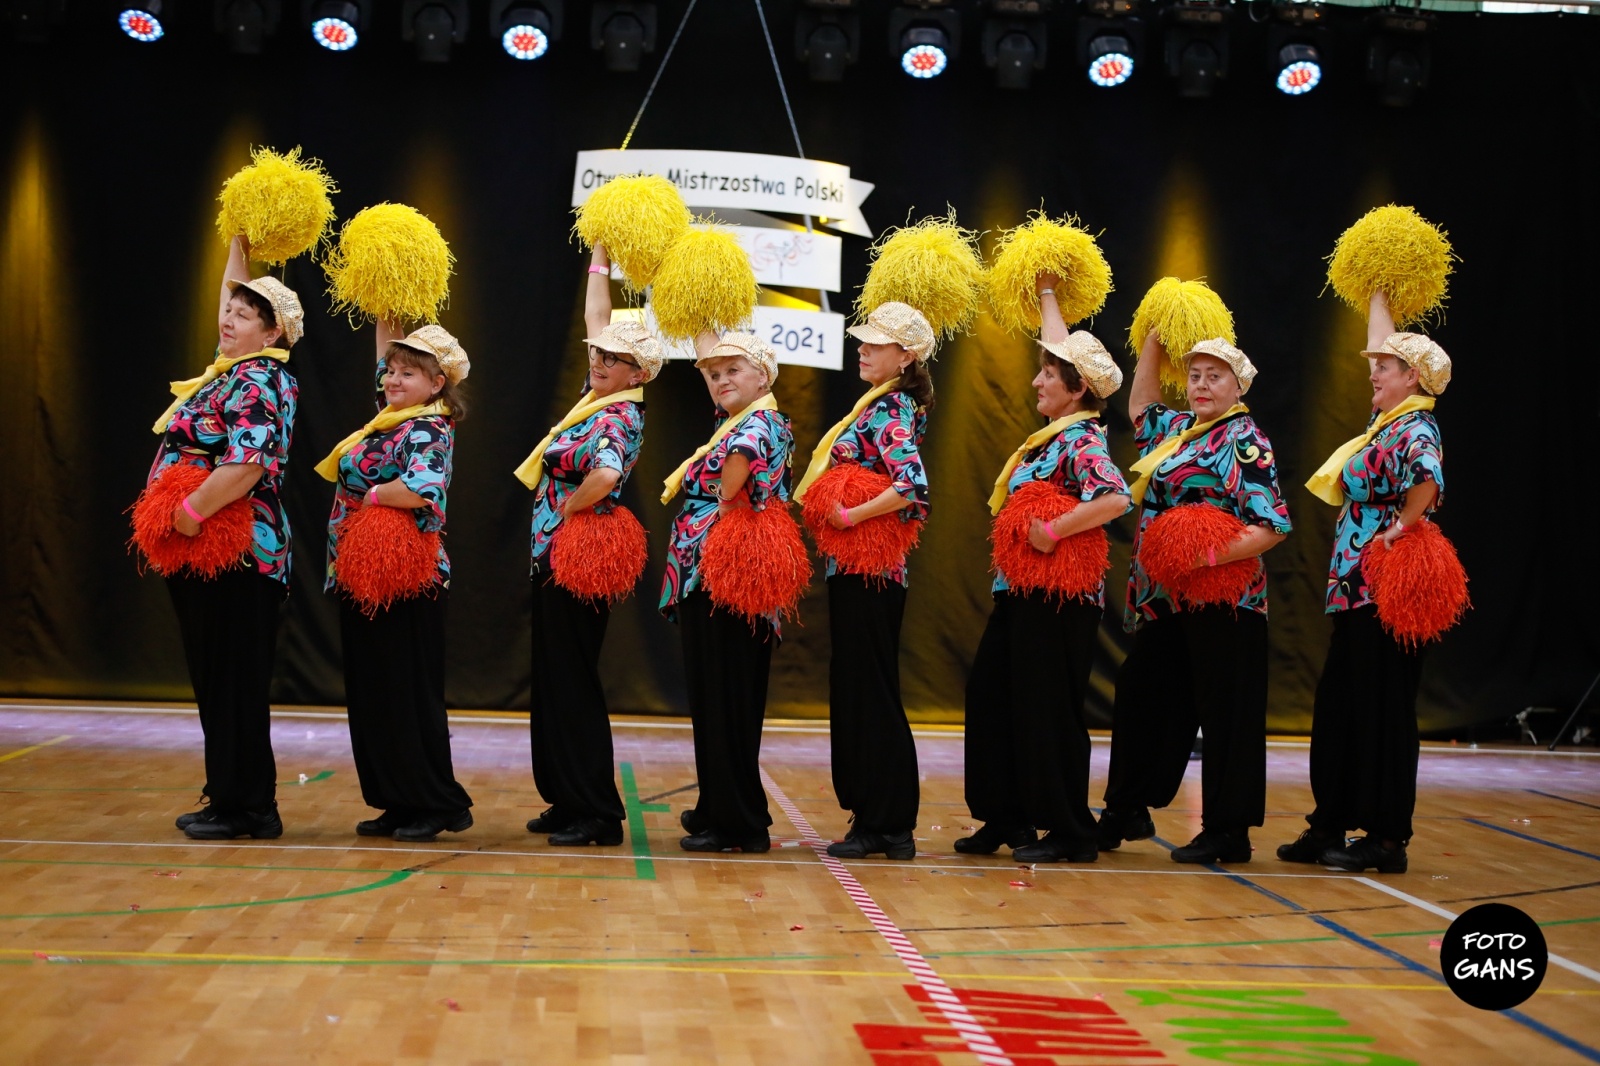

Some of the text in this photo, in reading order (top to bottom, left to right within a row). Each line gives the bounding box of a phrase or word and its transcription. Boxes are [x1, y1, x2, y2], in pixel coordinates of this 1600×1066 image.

[666, 168, 785, 195] Mistrzostwa
[795, 177, 844, 203] Polski
[771, 323, 825, 354] 2021
